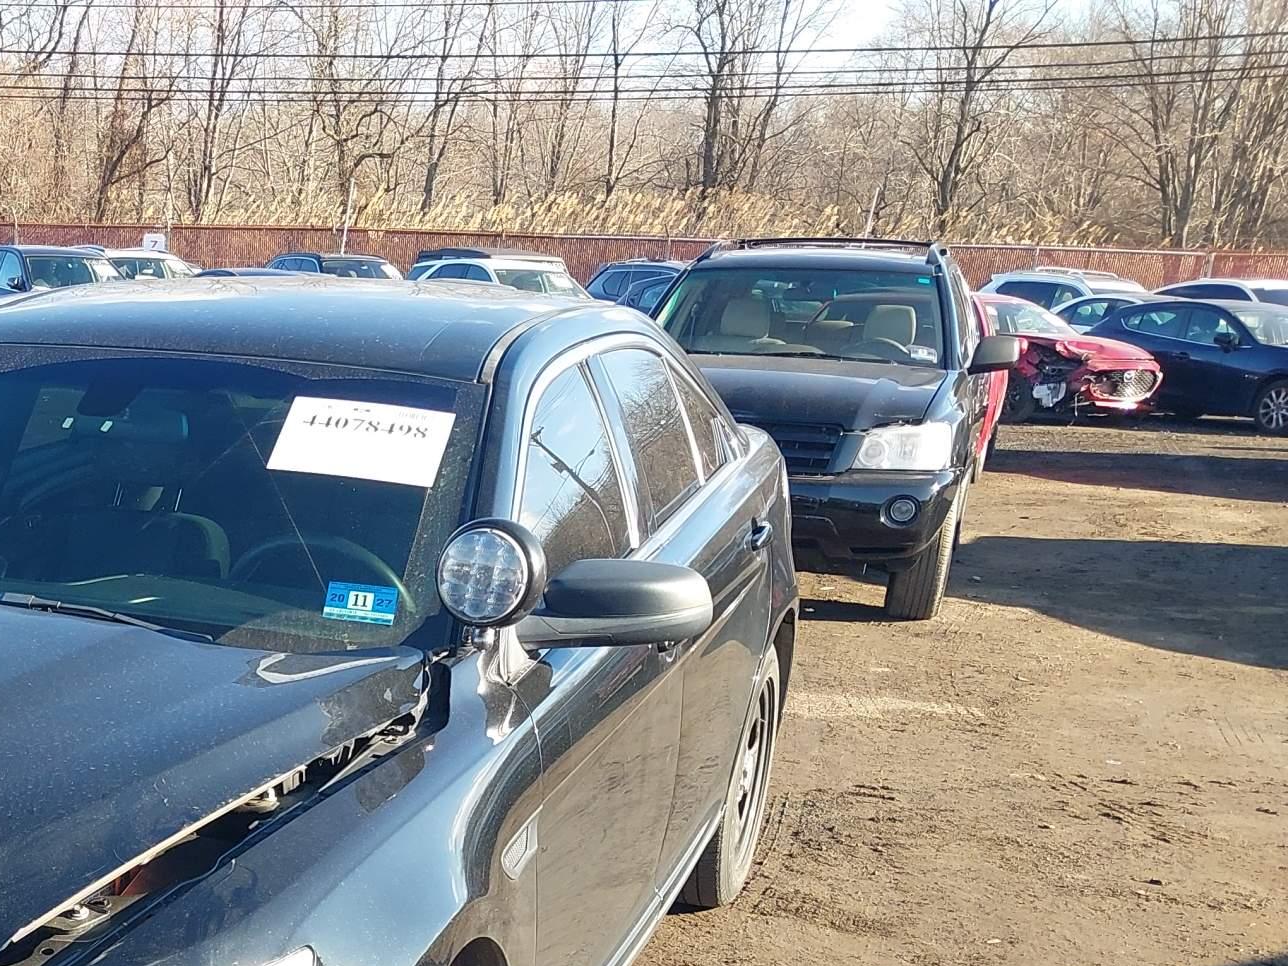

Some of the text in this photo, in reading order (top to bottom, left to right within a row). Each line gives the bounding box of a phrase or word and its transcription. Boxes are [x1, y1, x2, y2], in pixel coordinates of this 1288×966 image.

[150, 240, 158, 248] 7
[302, 414, 428, 438] 44078498
[330, 593, 393, 608] 20 11 27
